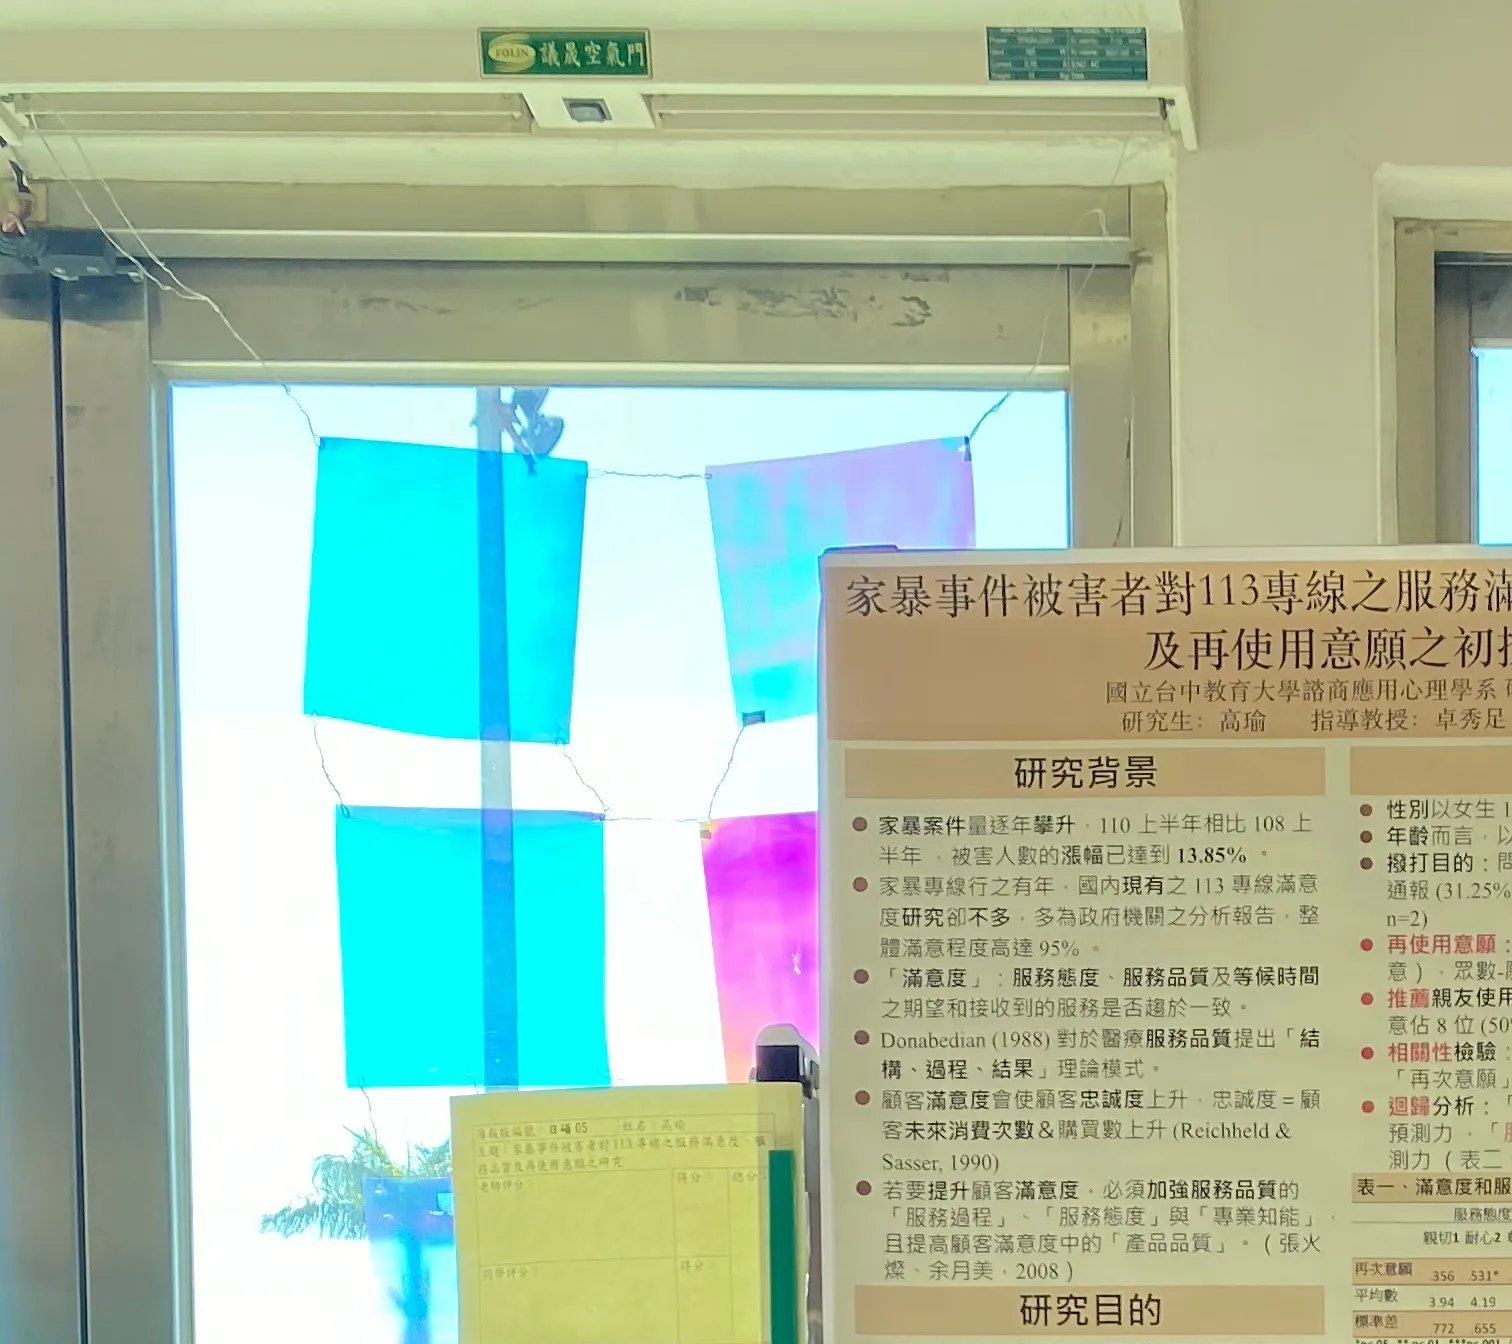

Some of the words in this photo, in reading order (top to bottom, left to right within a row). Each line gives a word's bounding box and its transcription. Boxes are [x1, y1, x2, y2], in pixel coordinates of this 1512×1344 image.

[1106, 677, 1496, 704] 國立台中教育大學諮商應用心理學系
[1014, 755, 1158, 790] 研究背景
[1386, 798, 1495, 820] 性別以女生
[1255, 815, 1285, 832] 108
[1196, 877, 1224, 895] 113
[1232, 873, 1318, 895] 專線滿意
[1387, 879, 1429, 901] 通報
[1386, 909, 1428, 930] n=2)
[879, 937, 1034, 959] 體滿意程度高達
[1388, 1014, 1430, 1036] 意佔
[1437, 1017, 1447, 1034] 8
[881, 1031, 986, 1049] Donabedian
[991, 1030, 1050, 1052] (1988)
[1172, 1121, 1269, 1140] (Reichheld
[1275, 1122, 1291, 1140] &
[882, 1153, 943, 1174] Sasser,
[951, 1153, 999, 1173] 1990)
[1019, 1292, 1161, 1327] 研究目的
